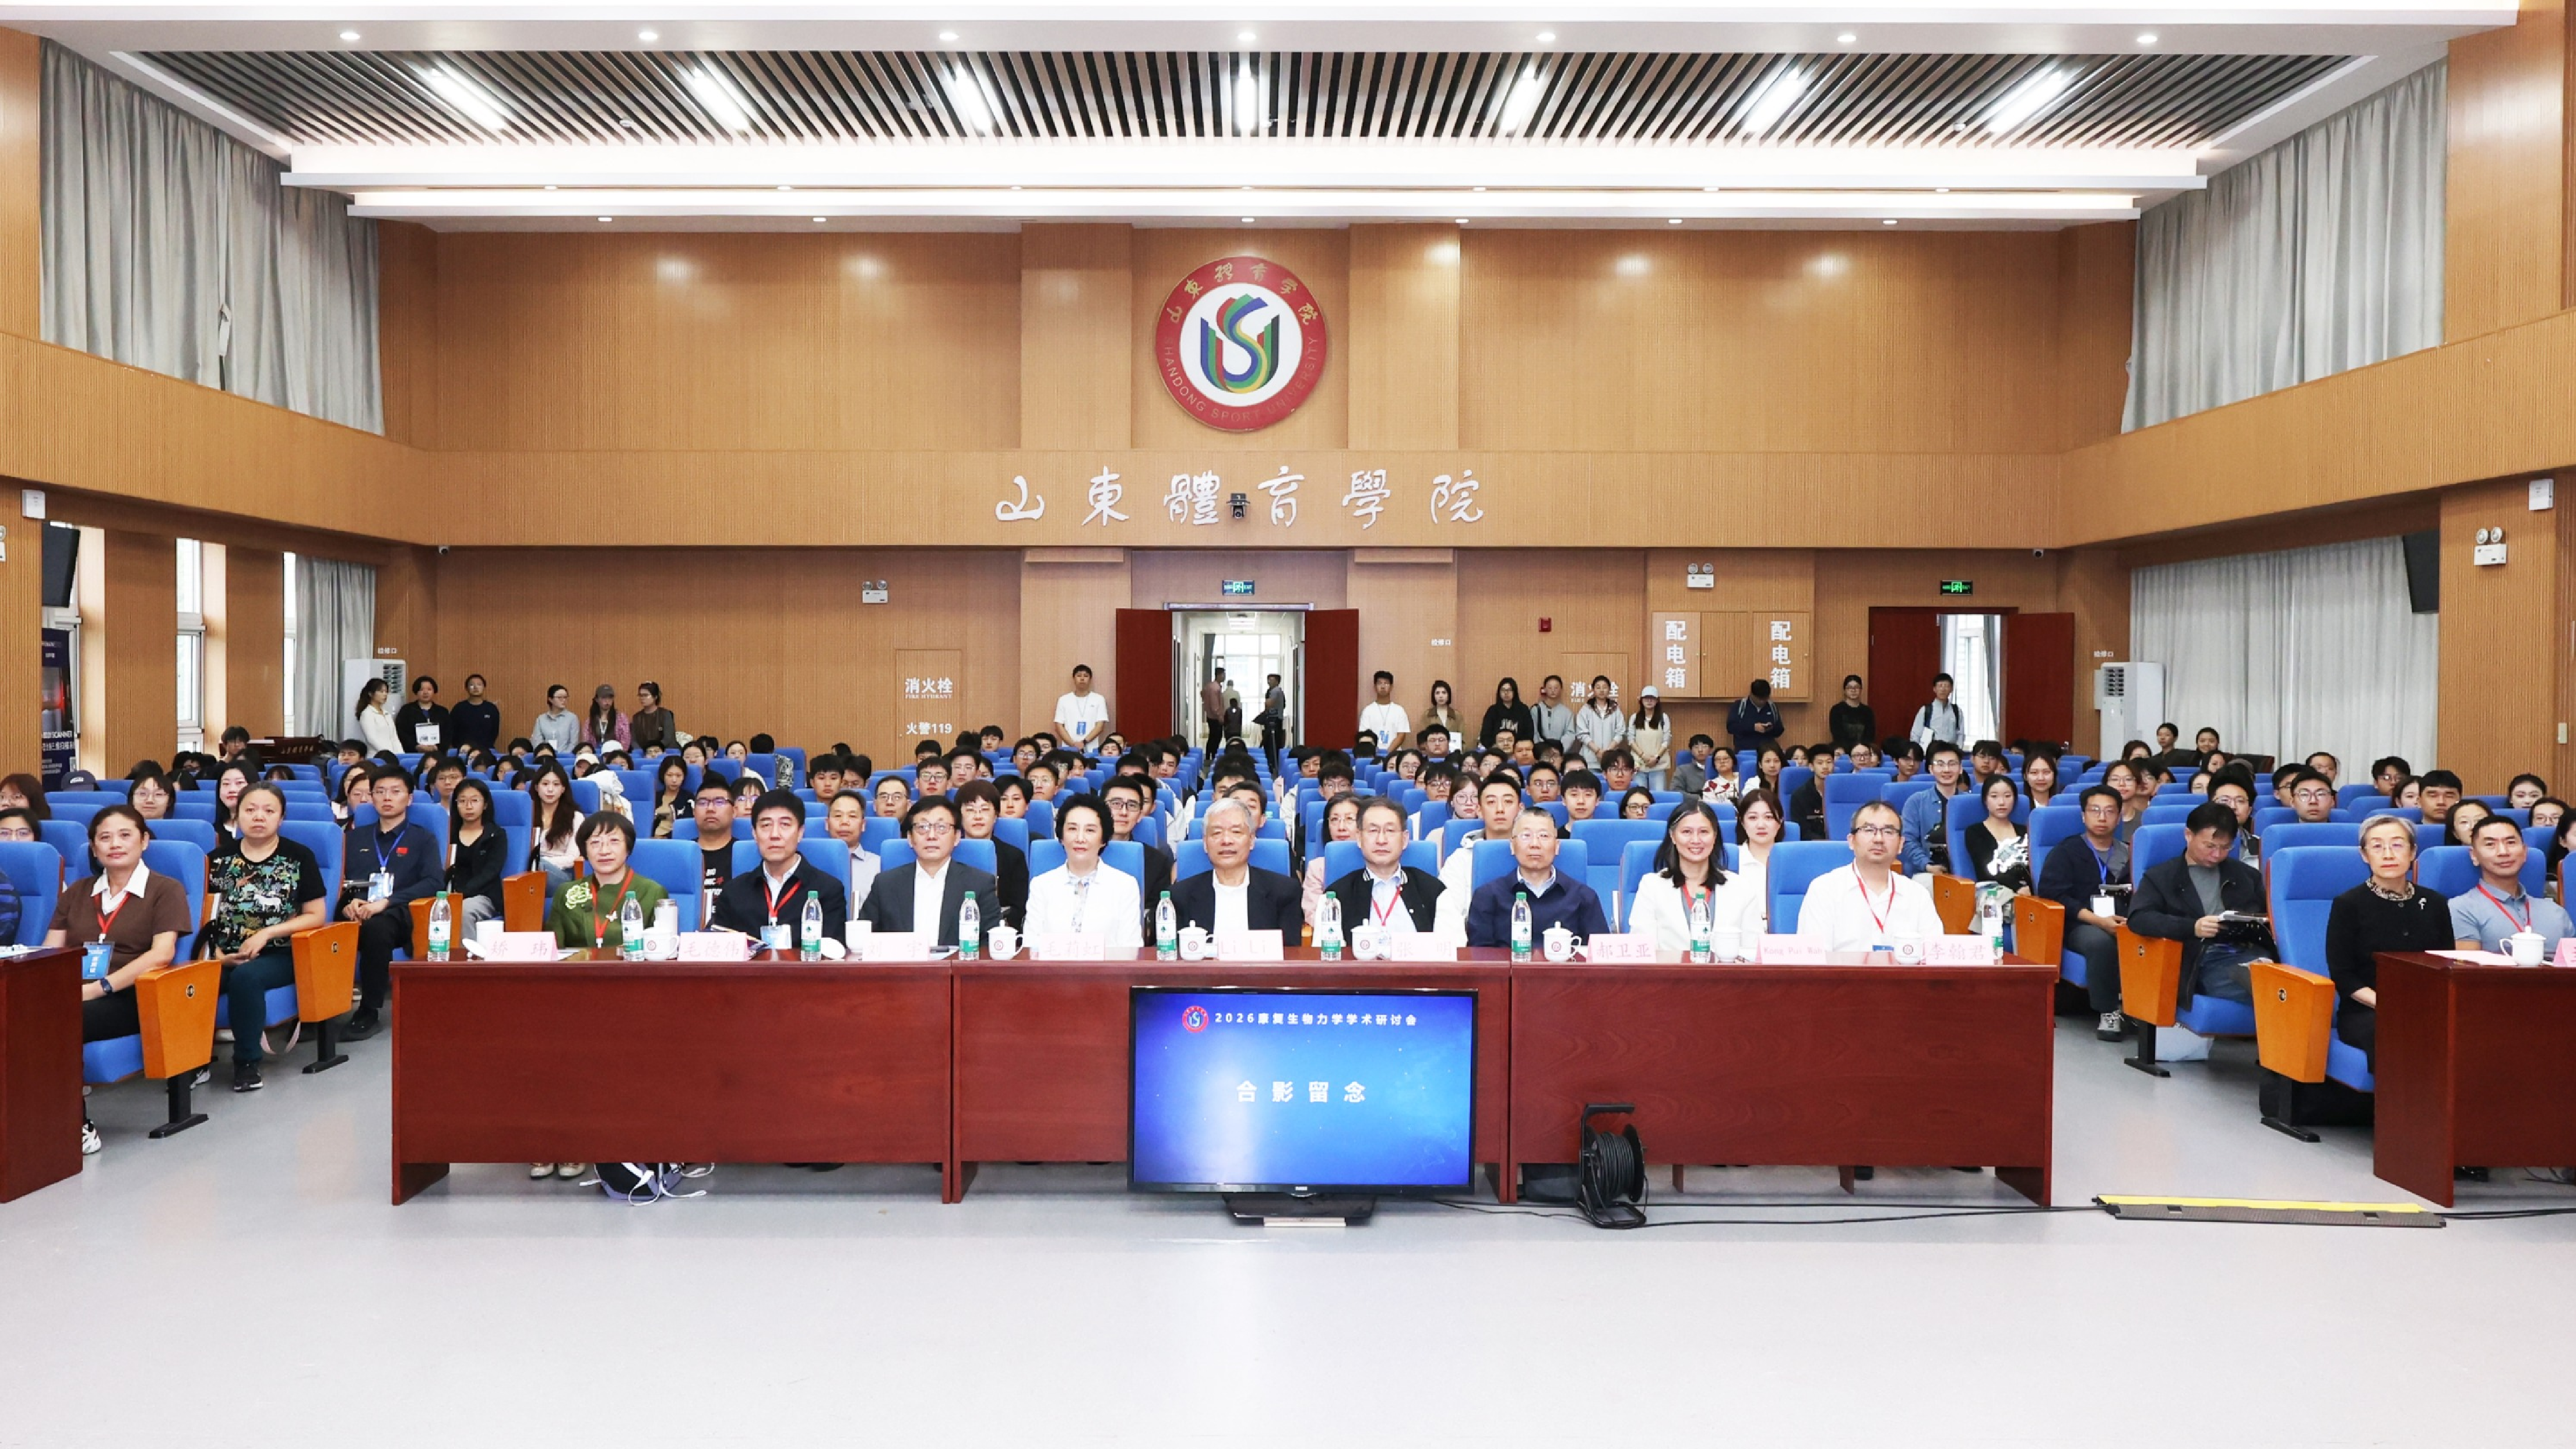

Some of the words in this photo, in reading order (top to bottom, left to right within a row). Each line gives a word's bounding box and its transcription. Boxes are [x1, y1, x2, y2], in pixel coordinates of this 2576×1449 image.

[1164, 337, 1207, 412] SHANDONG
[1211, 409, 1261, 422] SPORT
[1267, 336, 1318, 415] UNIVERSITY
[1664, 620, 1687, 688] 配电箱
[1770, 620, 1792, 689] 配电箱
[905, 677, 953, 694] 消火栓
[905, 722, 953, 735] 火警119
[1221, 939, 1236, 955] Li
[1249, 939, 1266, 955] Li
[1595, 941, 1653, 959] 郝卫亚
[1763, 946, 1784, 956] Kong
[1787, 946, 1802, 955] Pui
[1807, 946, 1823, 955] Wah
[1927, 942, 1987, 960] 李翰君
[1215, 1012, 1417, 1026] 2026康复生物力学学术研讨会
[1236, 1081, 1366, 1103] 合影留念
